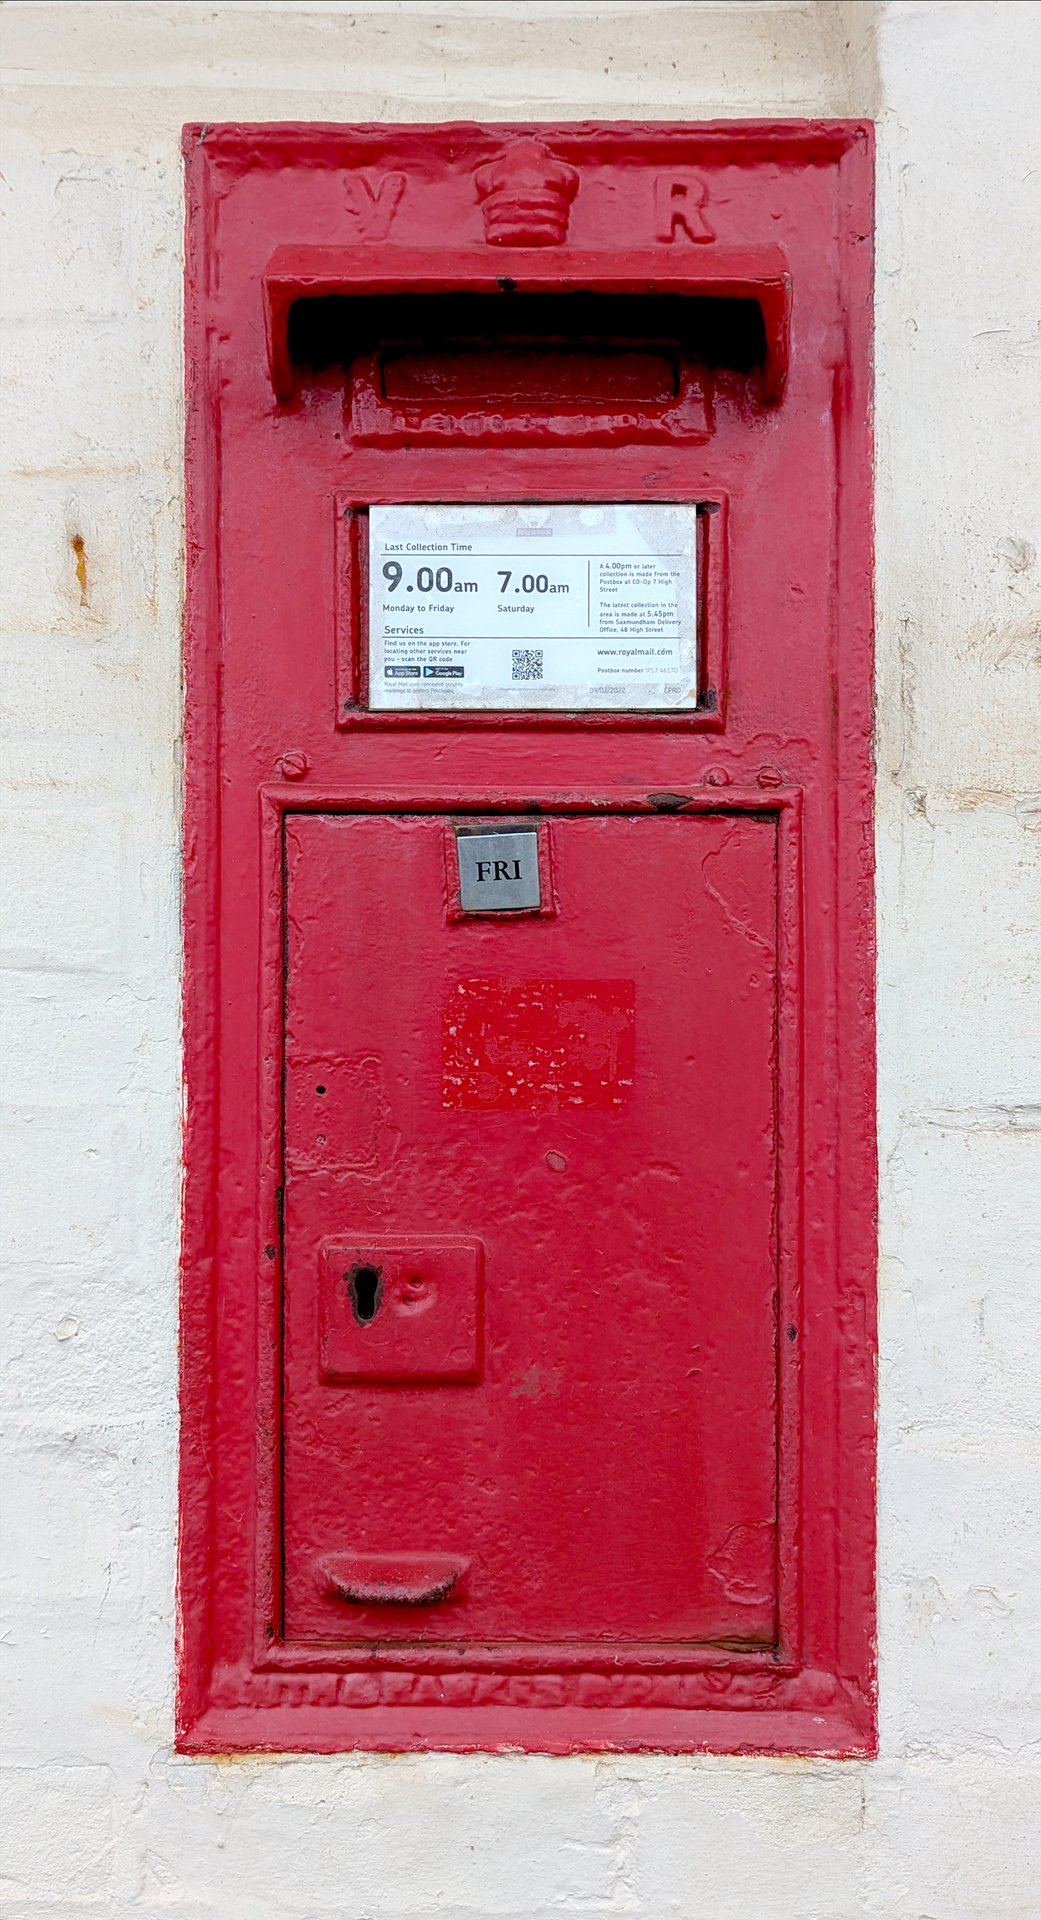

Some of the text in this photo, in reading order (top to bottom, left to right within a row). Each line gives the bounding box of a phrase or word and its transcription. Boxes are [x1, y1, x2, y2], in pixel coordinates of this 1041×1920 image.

[343, 172, 716, 551] V R Last Collection Time
[383, 561, 478, 592] 9.00am
[497, 570, 570, 593] 7.00am
[383, 605, 414, 613] Monday
[429, 605, 454, 613] Friday
[498, 605, 534, 613] Saturday
[384, 626, 424, 634] Services
[597, 648, 673, 656] www.royalmail.com
[476, 860, 522, 882] FRI
